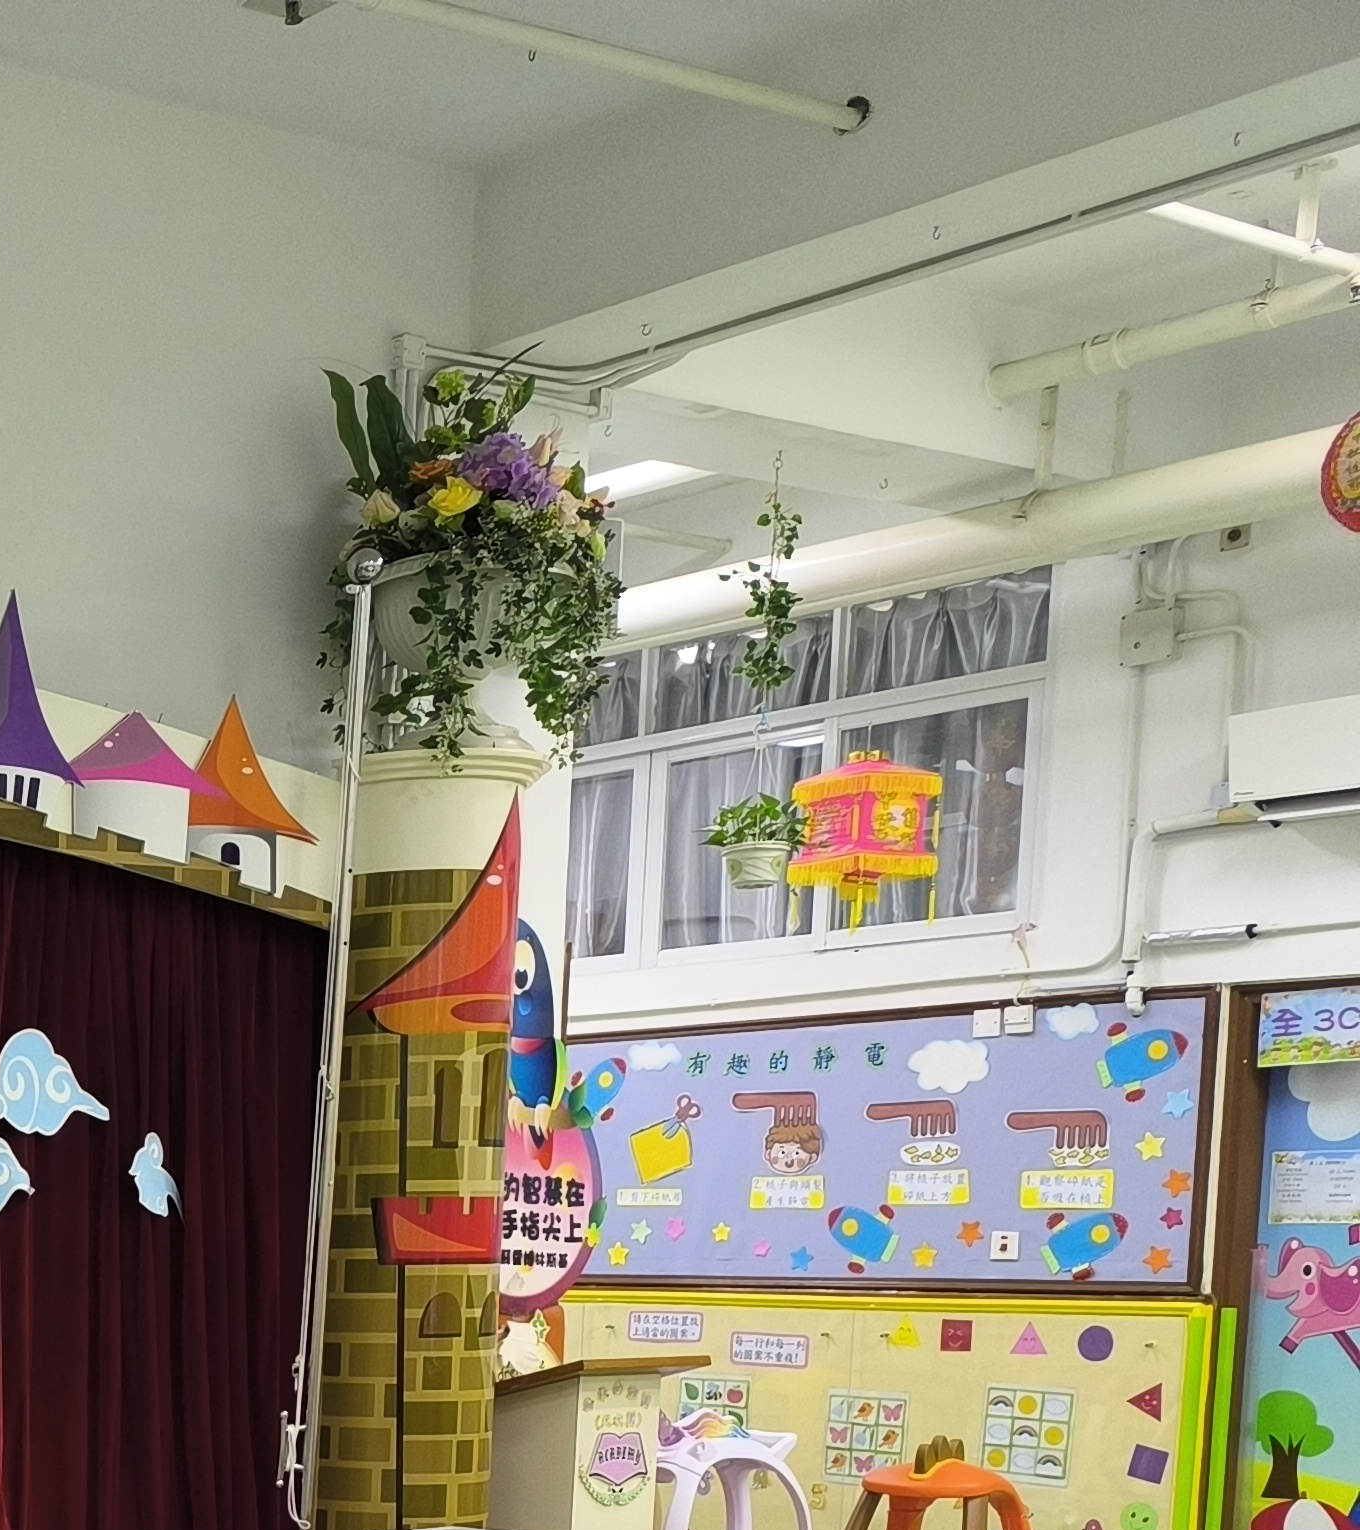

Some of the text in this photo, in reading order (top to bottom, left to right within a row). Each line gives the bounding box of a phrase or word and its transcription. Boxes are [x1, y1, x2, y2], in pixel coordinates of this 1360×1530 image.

[1271, 1008, 1303, 1038] 全
[687, 1043, 886, 1076] 有趣的靜電
[502, 1209, 583, 1243] 手指尖上
